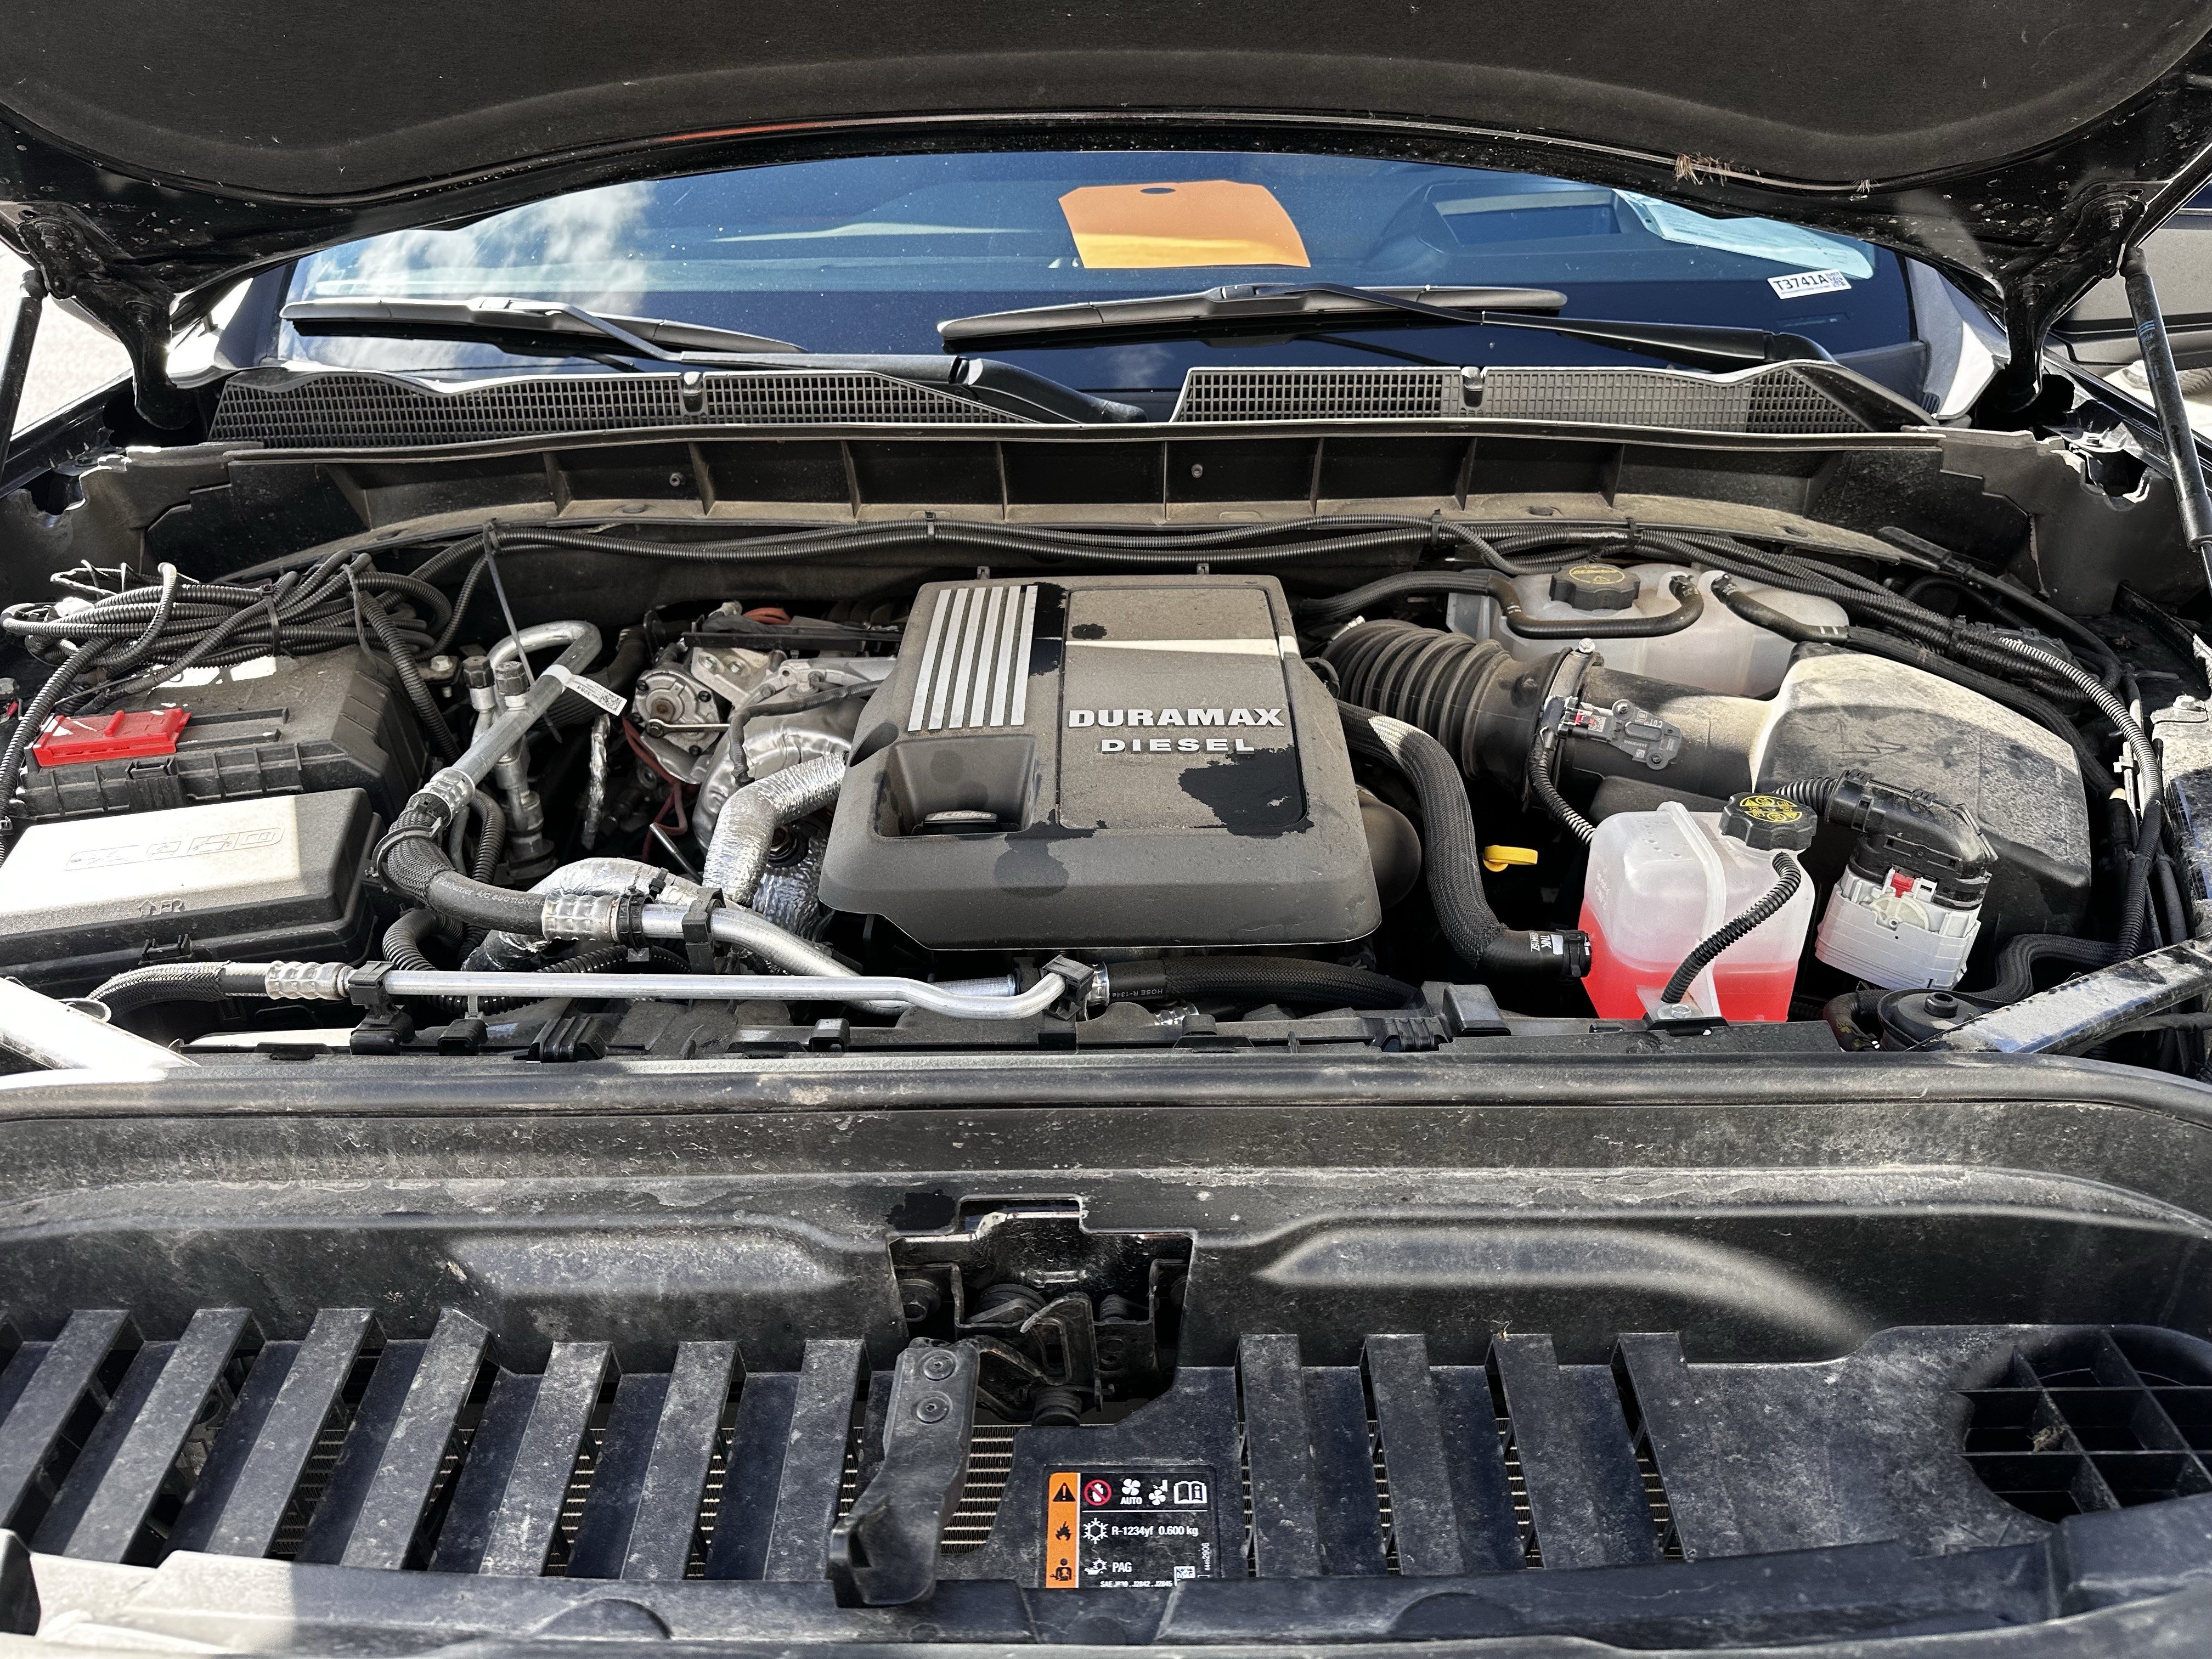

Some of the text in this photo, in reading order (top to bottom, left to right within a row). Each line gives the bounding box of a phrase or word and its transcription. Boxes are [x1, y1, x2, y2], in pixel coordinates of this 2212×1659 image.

[1773, 274, 1829, 290] T3741A
[1069, 708, 1284, 727] DURAMAX
[1102, 738, 1255, 752] DIESEL
[476, 890, 491, 899] A/C
[492, 894, 531, 905] SUCTION
[1539, 935, 1552, 949] TNK
[1120, 1497, 1143, 1505] AUTO
[1111, 1526, 1199, 1537] R-1234yf 0.600 kg
[1112, 1561, 1132, 1572] PAG
